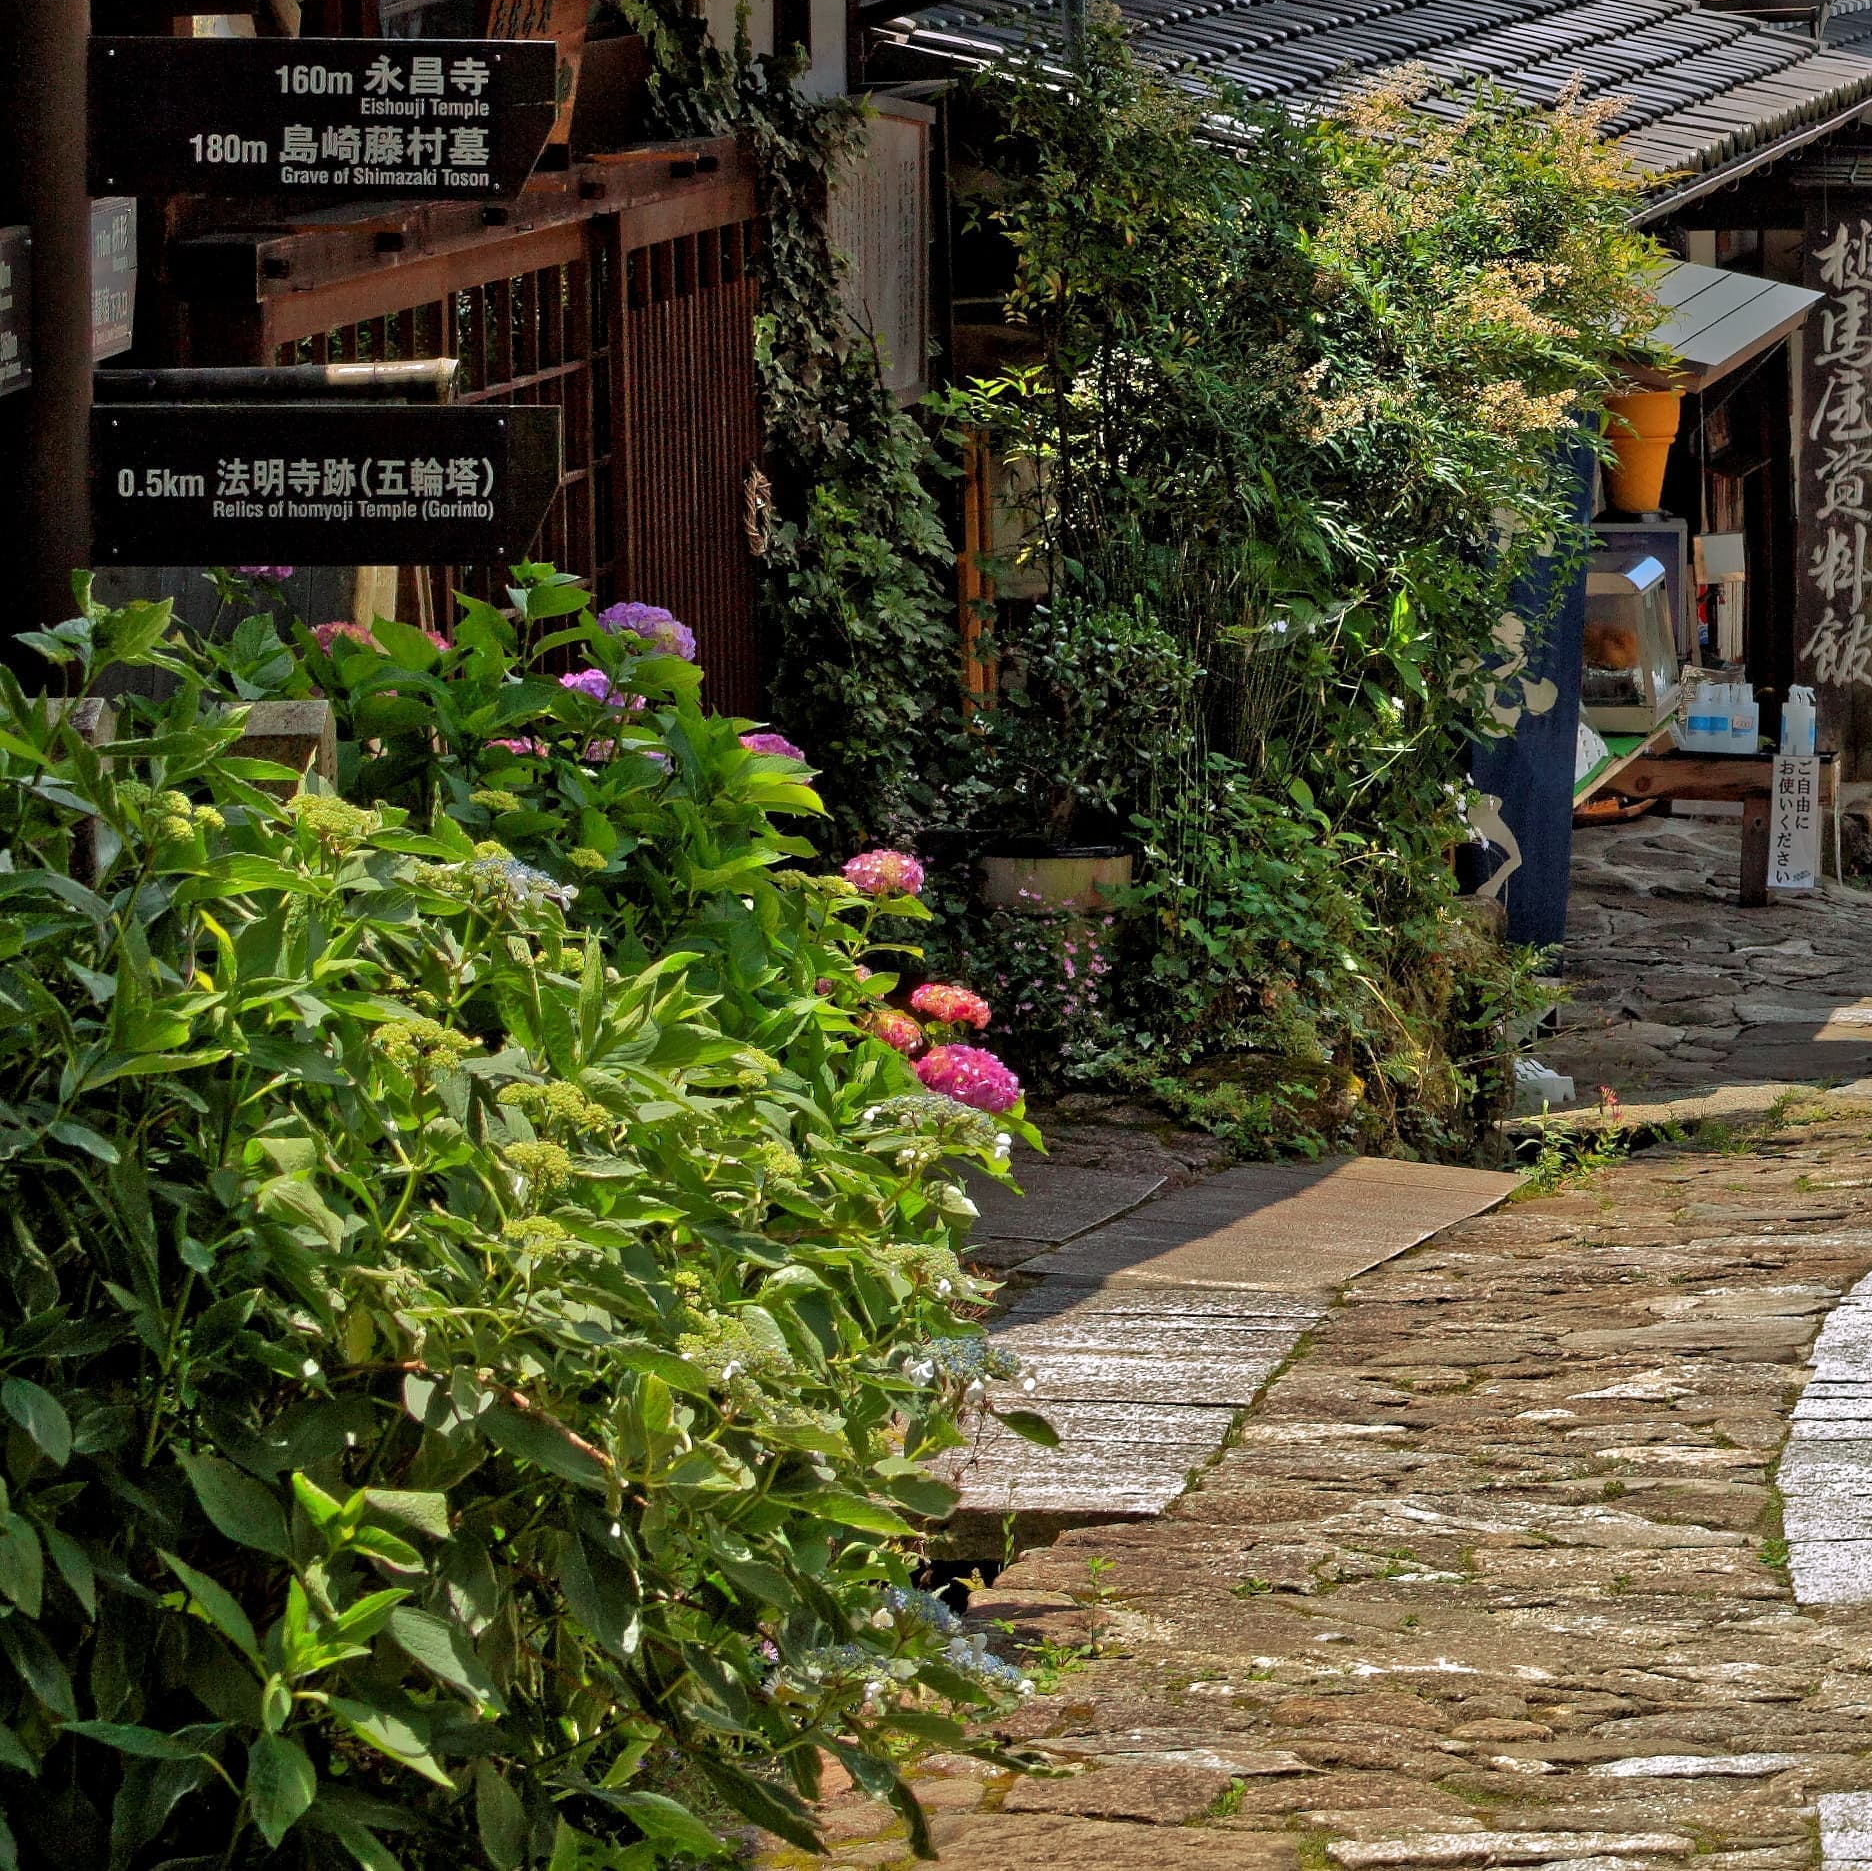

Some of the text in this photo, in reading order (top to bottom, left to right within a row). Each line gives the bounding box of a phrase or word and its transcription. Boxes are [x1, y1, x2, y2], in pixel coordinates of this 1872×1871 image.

[275, 55, 490, 96] 160m 永昌寺
[361, 98, 489, 119] Eishouji Temple
[189, 124, 490, 166] 180m 島崎藤村墓
[281, 166, 490, 186] Grave of Shimazaki Toson
[118, 468, 205, 497] 0.5km
[212, 500, 494, 521] Relics of homyoji Temple (Gorinto)
[1795, 760, 1813, 830] ご自由に
[1776, 760, 1796, 884] お使いください
